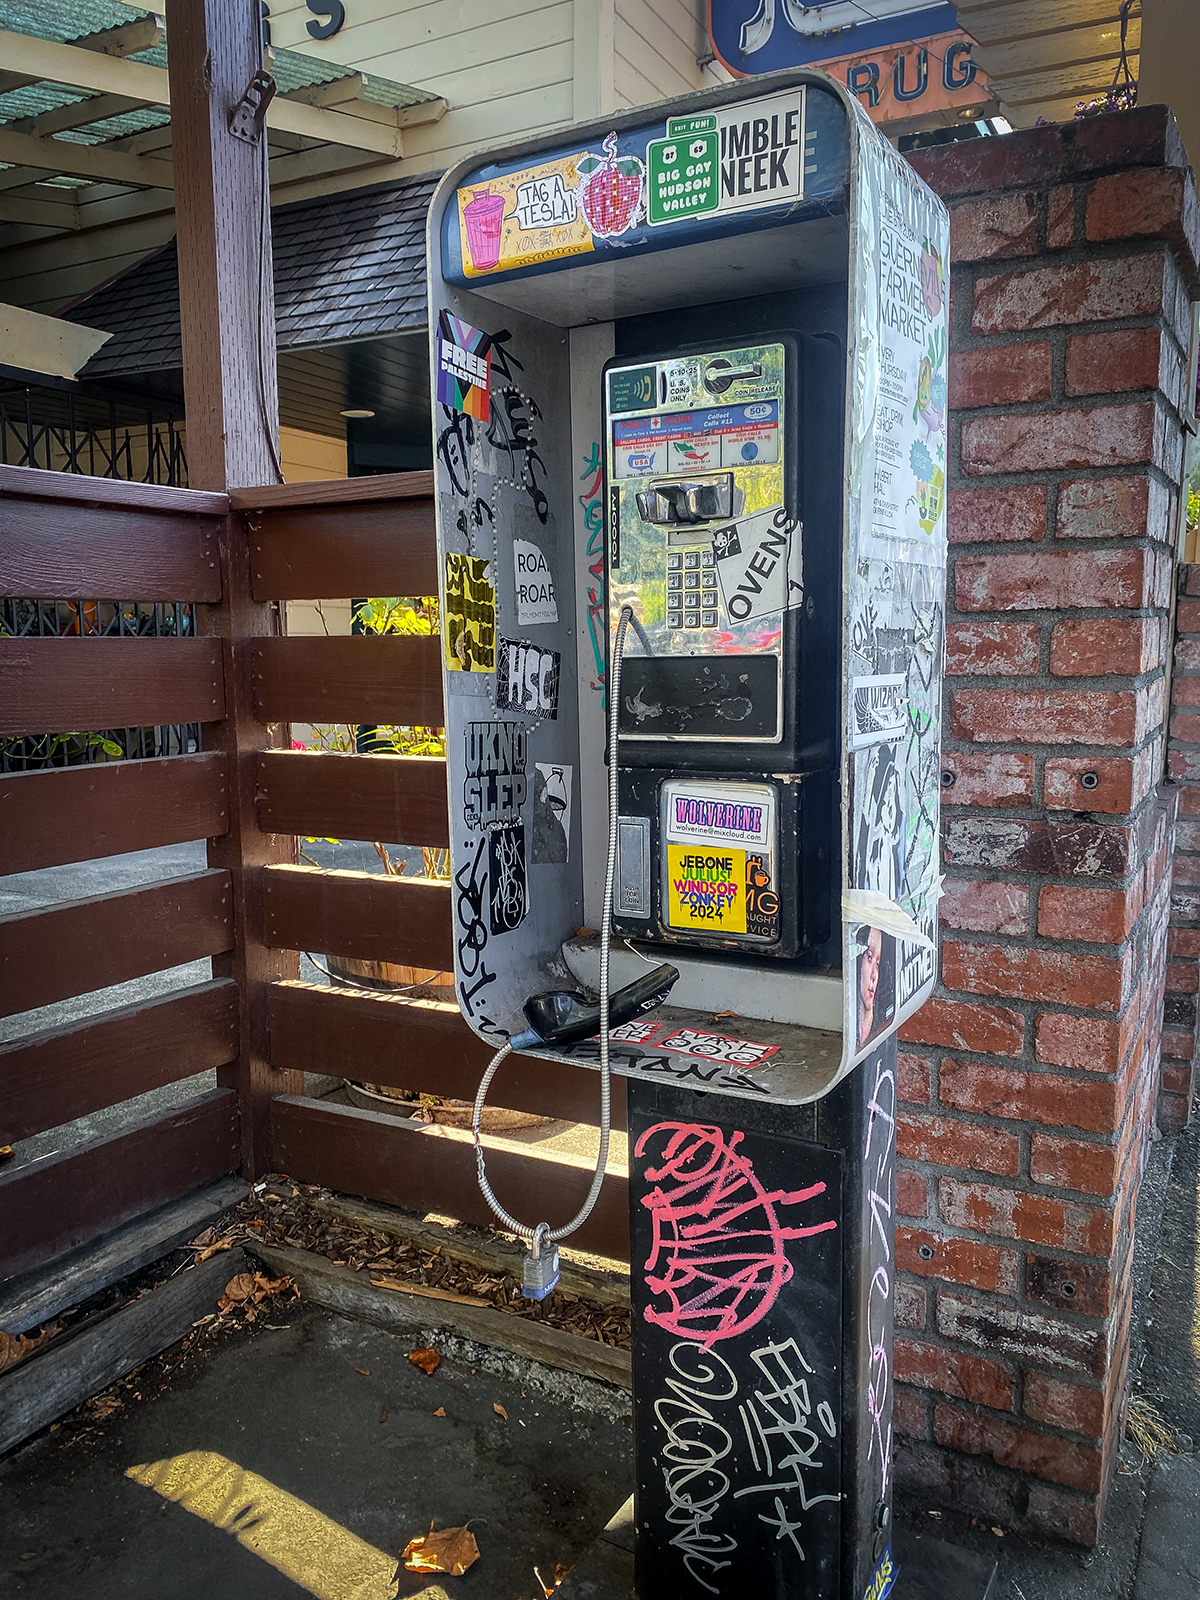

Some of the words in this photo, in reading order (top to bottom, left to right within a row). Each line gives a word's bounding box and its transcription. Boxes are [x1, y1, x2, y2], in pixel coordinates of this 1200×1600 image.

[690, 119, 710, 130] FUN!
[693, 145, 704, 154] 69
[657, 168, 680, 184] BIG
[685, 160, 712, 177] GAY
[520, 182, 550, 204] TAG
[554, 177, 564, 200] A
[659, 176, 711, 199] HUDSON
[519, 194, 574, 226] TESLA!
[662, 192, 707, 212] VALLEY
[881, 261, 934, 324] FARMERS
[881, 298, 927, 348] MARKET
[441, 338, 488, 380] FREE
[441, 360, 487, 391] PALESTINE
[670, 386, 691, 395] COINS
[670, 394, 687, 403] ONLY
[620, 419, 650, 430] PUBLIC
[663, 415, 693, 425] PHONE
[707, 411, 731, 420] Collect
[518, 553, 550, 573] ROA
[727, 508, 798, 620] OVENS
[520, 584, 556, 604] ROAR
[508, 643, 554, 712] HSC
[464, 775, 528, 826] SLEP
[675, 797, 763, 834] WOLVERINE
[675, 824, 762, 841] wolverine@mixcloud.com
[679, 854, 734, 872] JEBONE
[682, 867, 731, 883] JULIUS!
[673, 878, 738, 897] WINDSOR
[679, 891, 735, 909] ZONKEY
[689, 904, 724, 921] 2024
